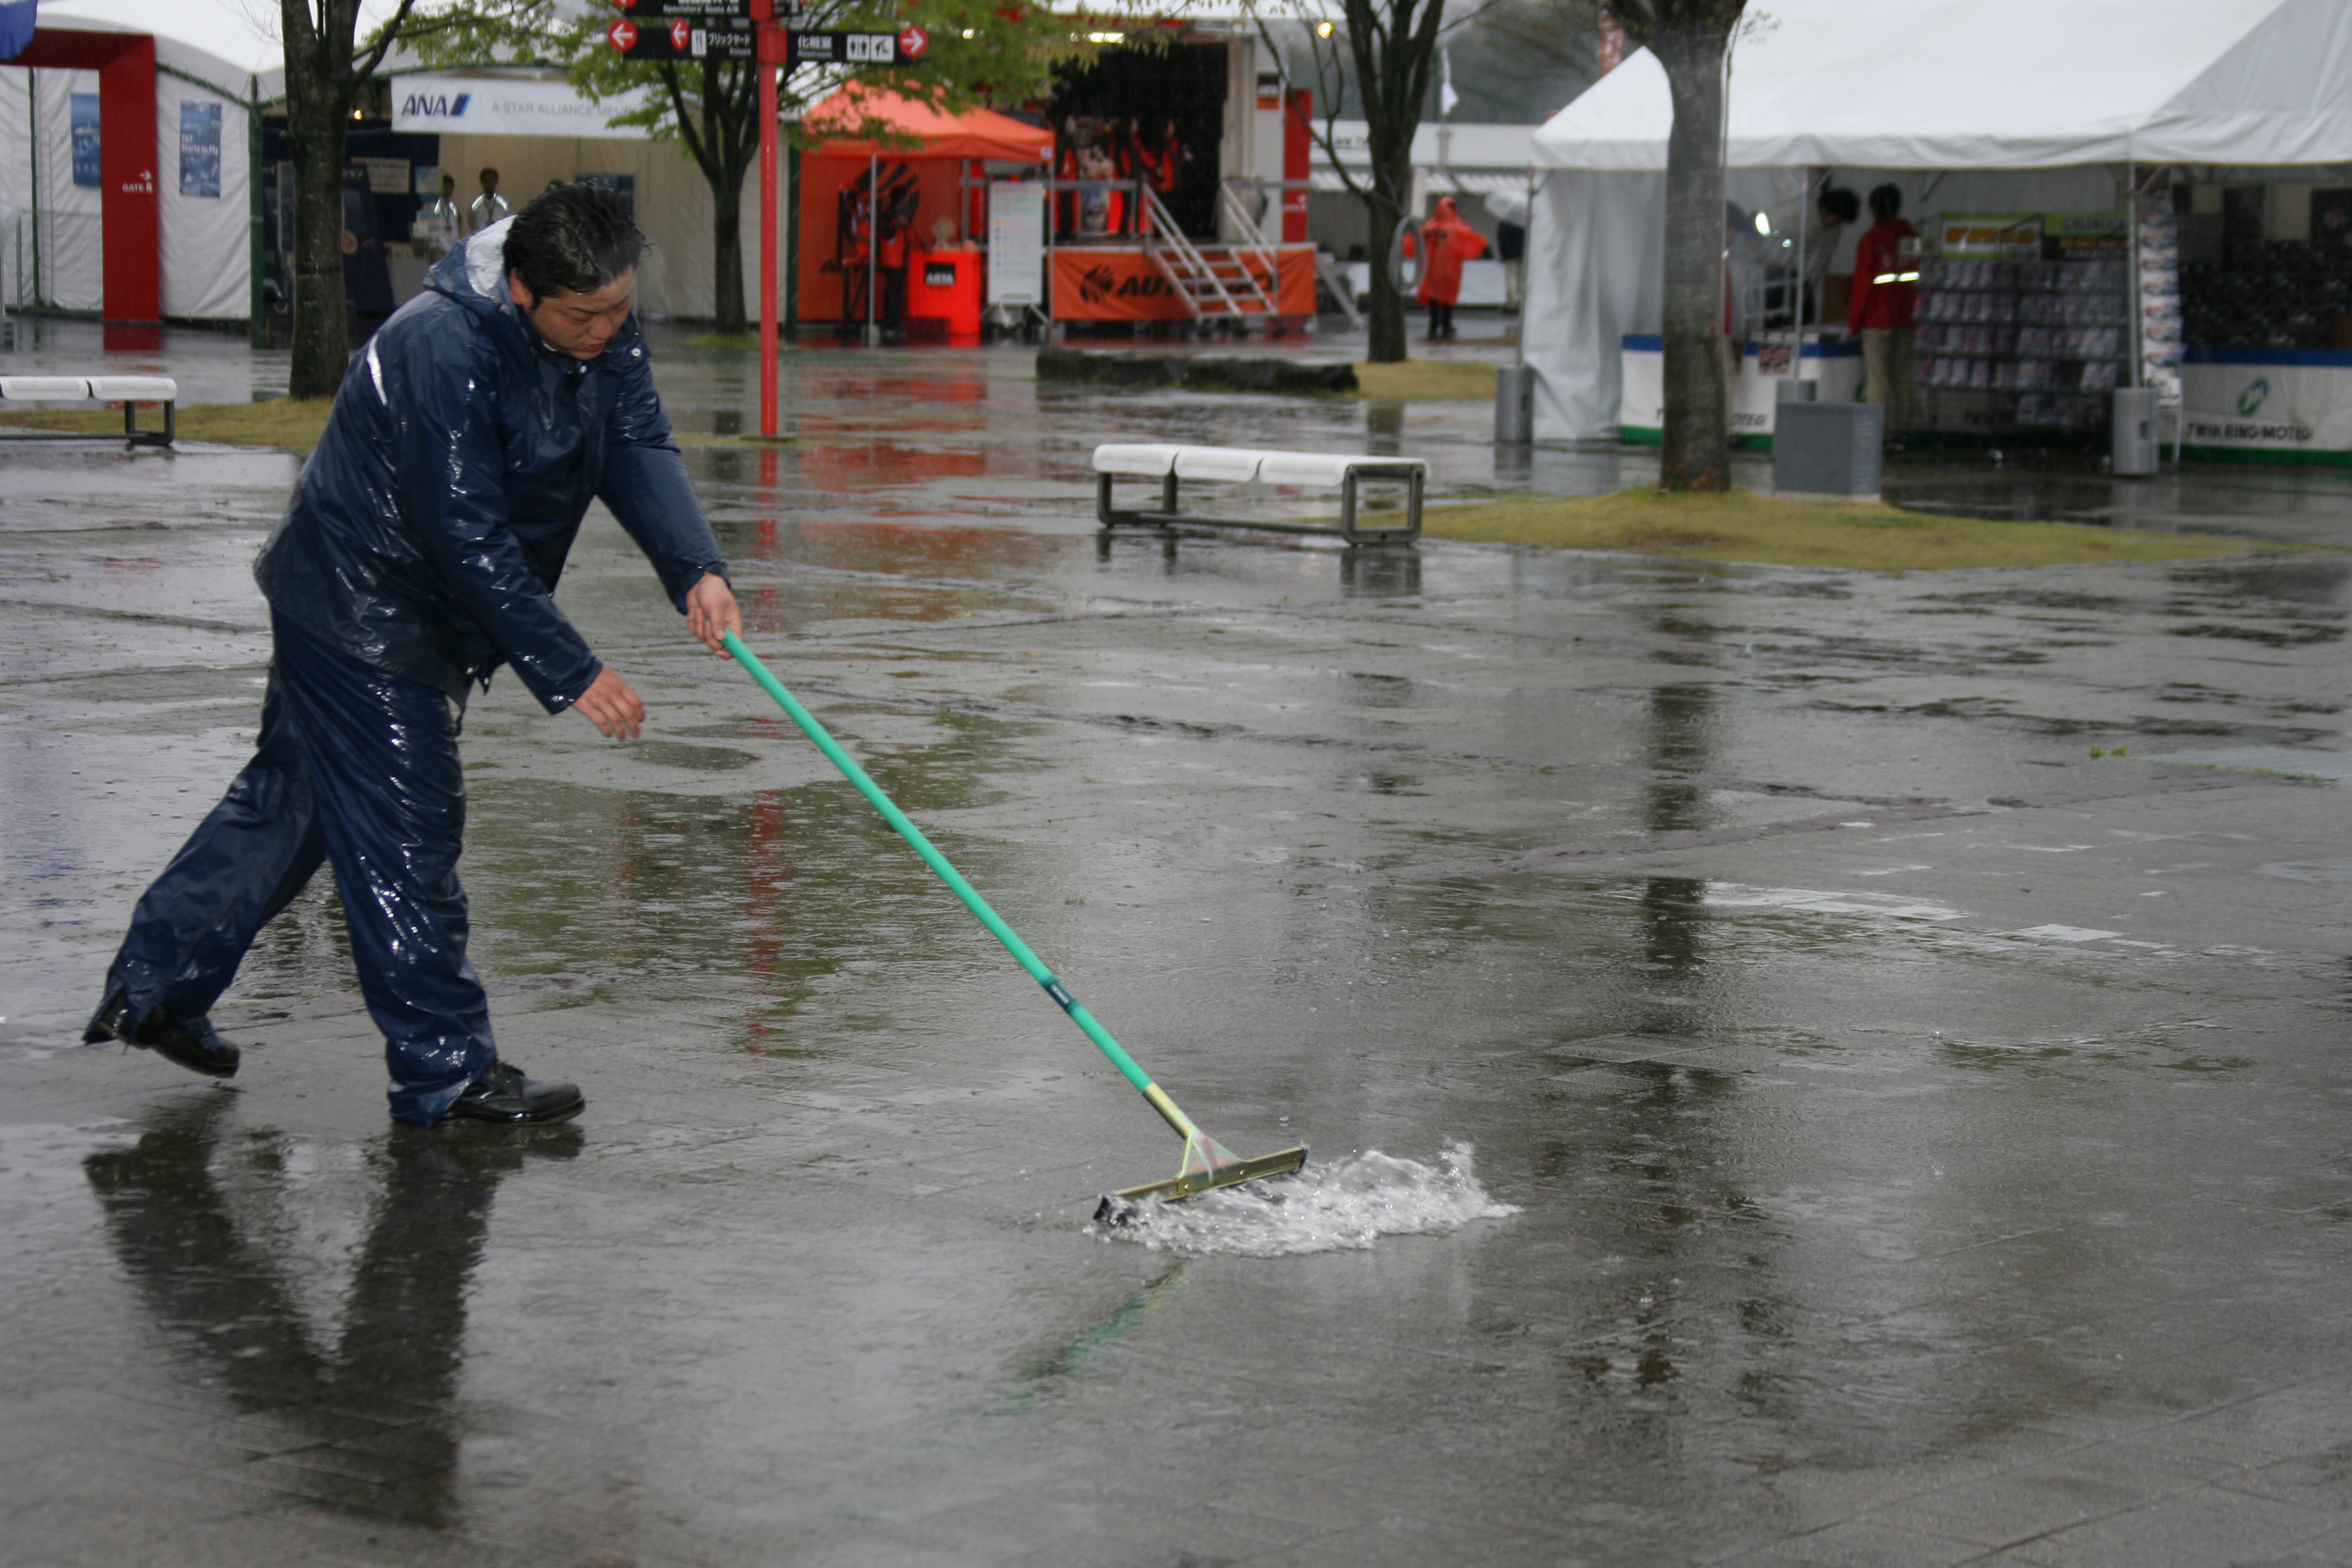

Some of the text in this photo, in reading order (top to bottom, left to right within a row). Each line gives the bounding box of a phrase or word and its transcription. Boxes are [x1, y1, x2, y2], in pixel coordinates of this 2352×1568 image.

[797, 35, 832, 49] 化粧室
[797, 49, 832, 58] Restroom
[403, 95, 447, 116] ANA
[491, 102, 499, 112] A
[503, 103, 533, 114] STAR
[538, 103, 592, 115] ALLIANCE
[122, 183, 144, 192] GATE
[2187, 422, 2314, 441] TWIN RING MOTEGI
